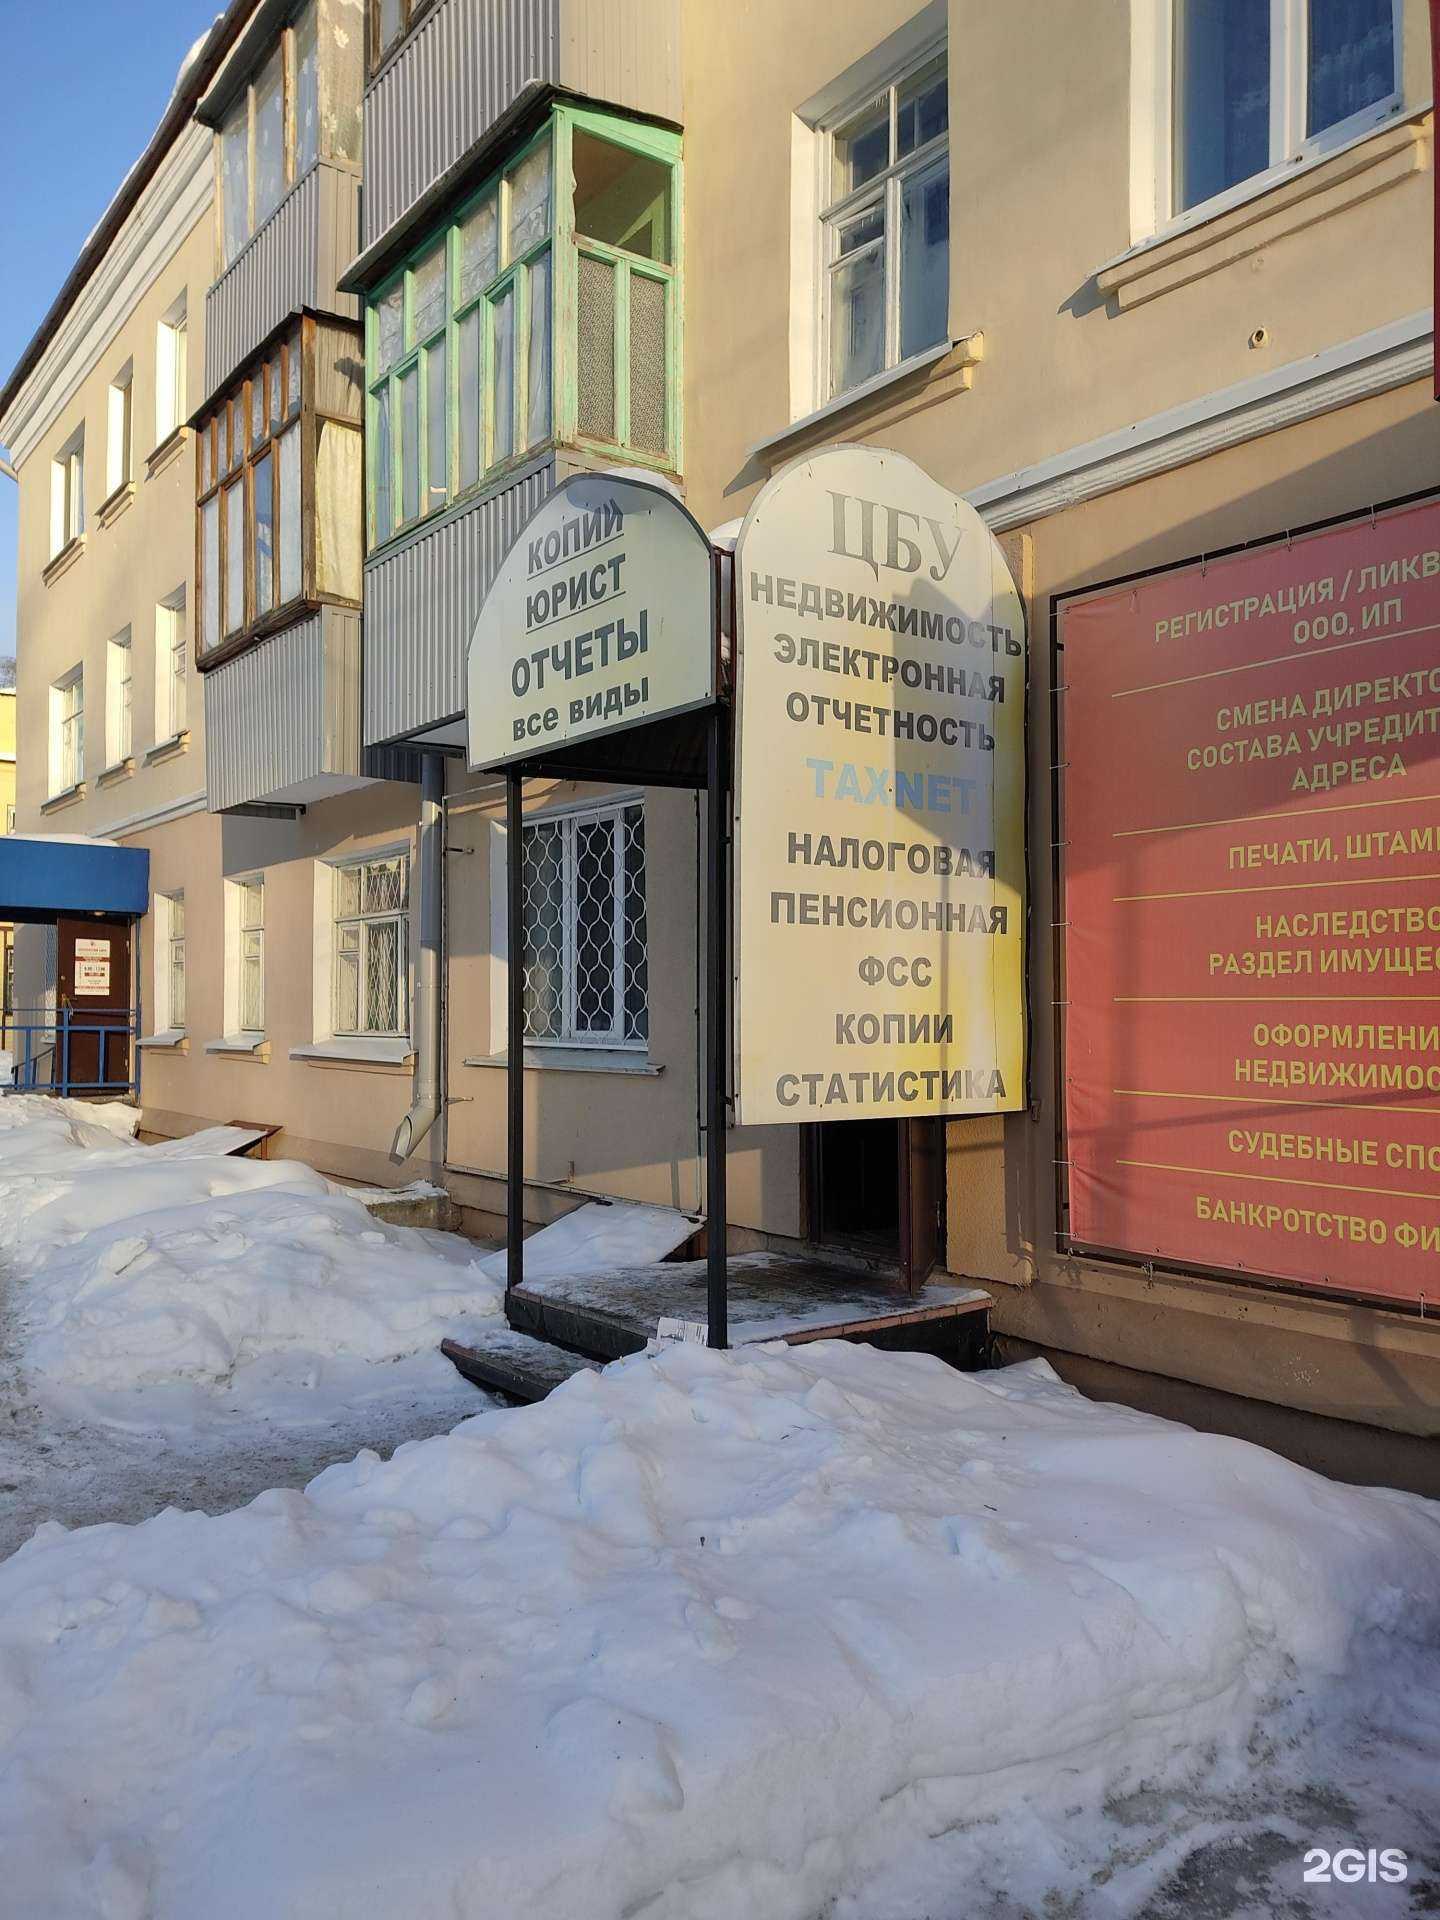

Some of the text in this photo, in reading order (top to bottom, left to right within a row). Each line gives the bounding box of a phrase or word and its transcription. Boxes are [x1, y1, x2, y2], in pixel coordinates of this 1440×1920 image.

[528, 498, 624, 575] КОПИИ
[826, 490, 968, 583] ЦБУ
[527, 553, 625, 628] ЮРИСТ
[1155, 577, 1334, 642] РЕГИСТРАЦИЯ
[1362, 598, 1403, 630] ИП
[750, 572, 1022, 657] НЕДВИЖИМОСТЬ
[511, 609, 648, 697] ОТЧЕТЫ
[774, 633, 1005, 703] ЭЛЕКТРОННАЯ
[513, 677, 649, 741] все виды
[786, 691, 995, 751] ОТЧЕТНОСТЬ
[1216, 694, 1307, 731] СМЕНА
[1187, 707, 1440, 770] СОСТАВА УЧРЕДИТ
[806, 757, 977, 815] TAXNET
[1291, 752, 1407, 792] АДРЕСА
[788, 832, 996, 879] НАЛОГОВАЯ
[1229, 826, 1440, 869] ПЕЧАТИ, ШТАМ
[770, 891, 1008, 935] ПЕНСИОННАЯ
[1255, 906, 1440, 939] НАСЛЕДСТВО
[858, 955, 932, 987] ФСС
[1209, 950, 1312, 979] РАЗДЕЛ
[835, 1013, 953, 1045] КОПИИ
[1253, 1023, 1440, 1051] ОФОРМЛЕНИ
[776, 1069, 1006, 1107] СТАТИСТИКА
[1228, 1129, 1378, 1166] СУДЕБНЫЕ
[1196, 1196, 1387, 1245] БАНКРОТСТВО
